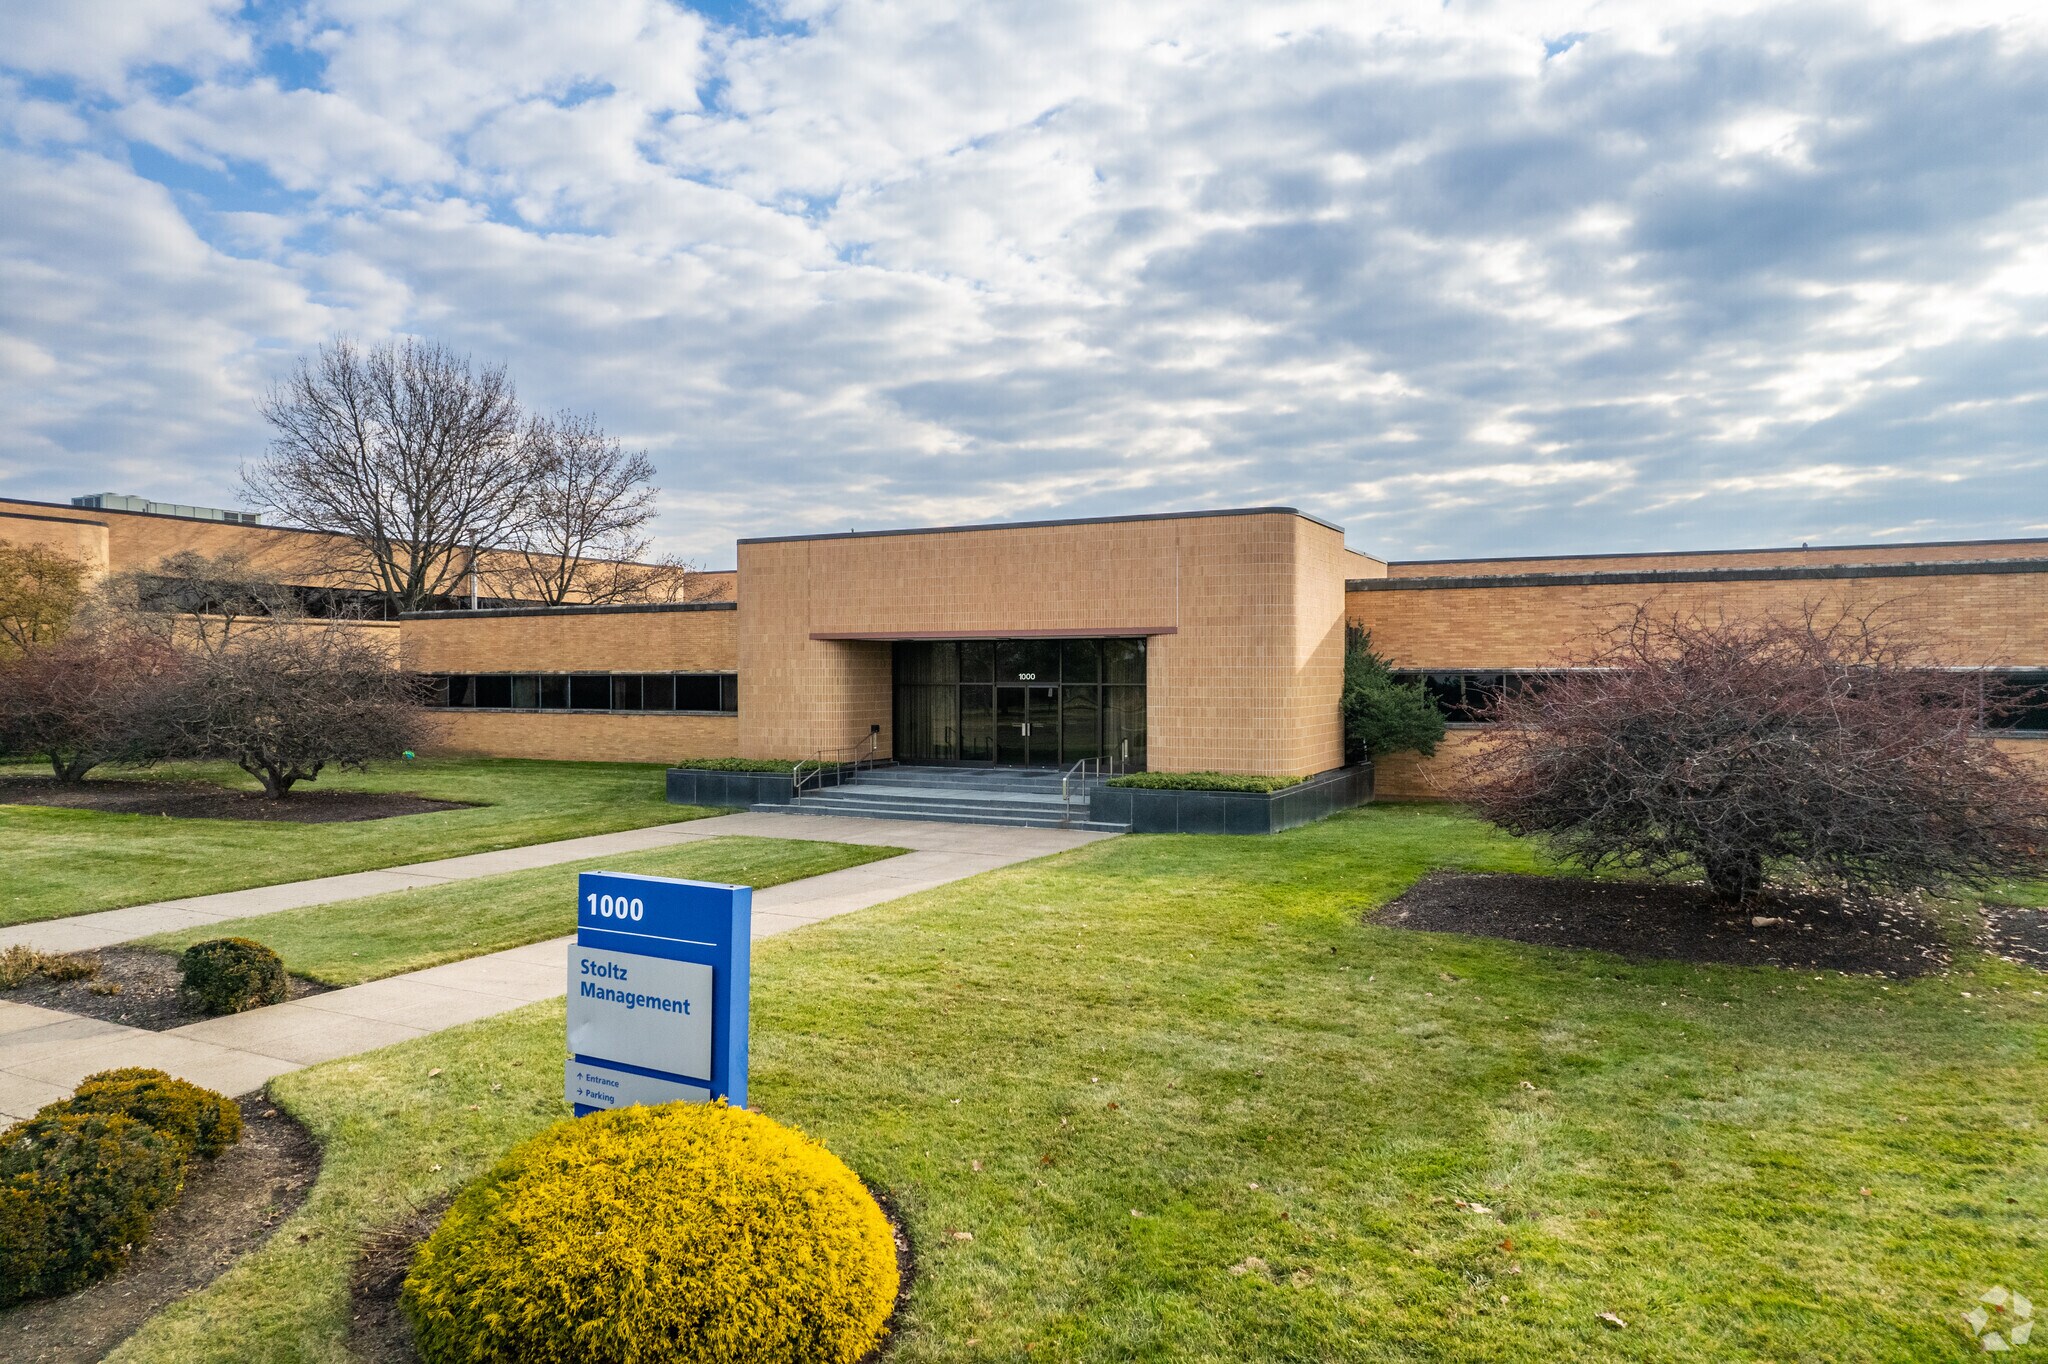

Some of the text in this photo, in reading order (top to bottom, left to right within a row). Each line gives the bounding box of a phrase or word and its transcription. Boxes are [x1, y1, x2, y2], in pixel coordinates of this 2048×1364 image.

[1018, 673, 1036, 681] 1000
[587, 893, 644, 921] 1000
[580, 959, 628, 981] Stoltz
[580, 981, 691, 1015] Management
[586, 1073, 620, 1088] Entrance
[585, 1089, 615, 1104] Parking
